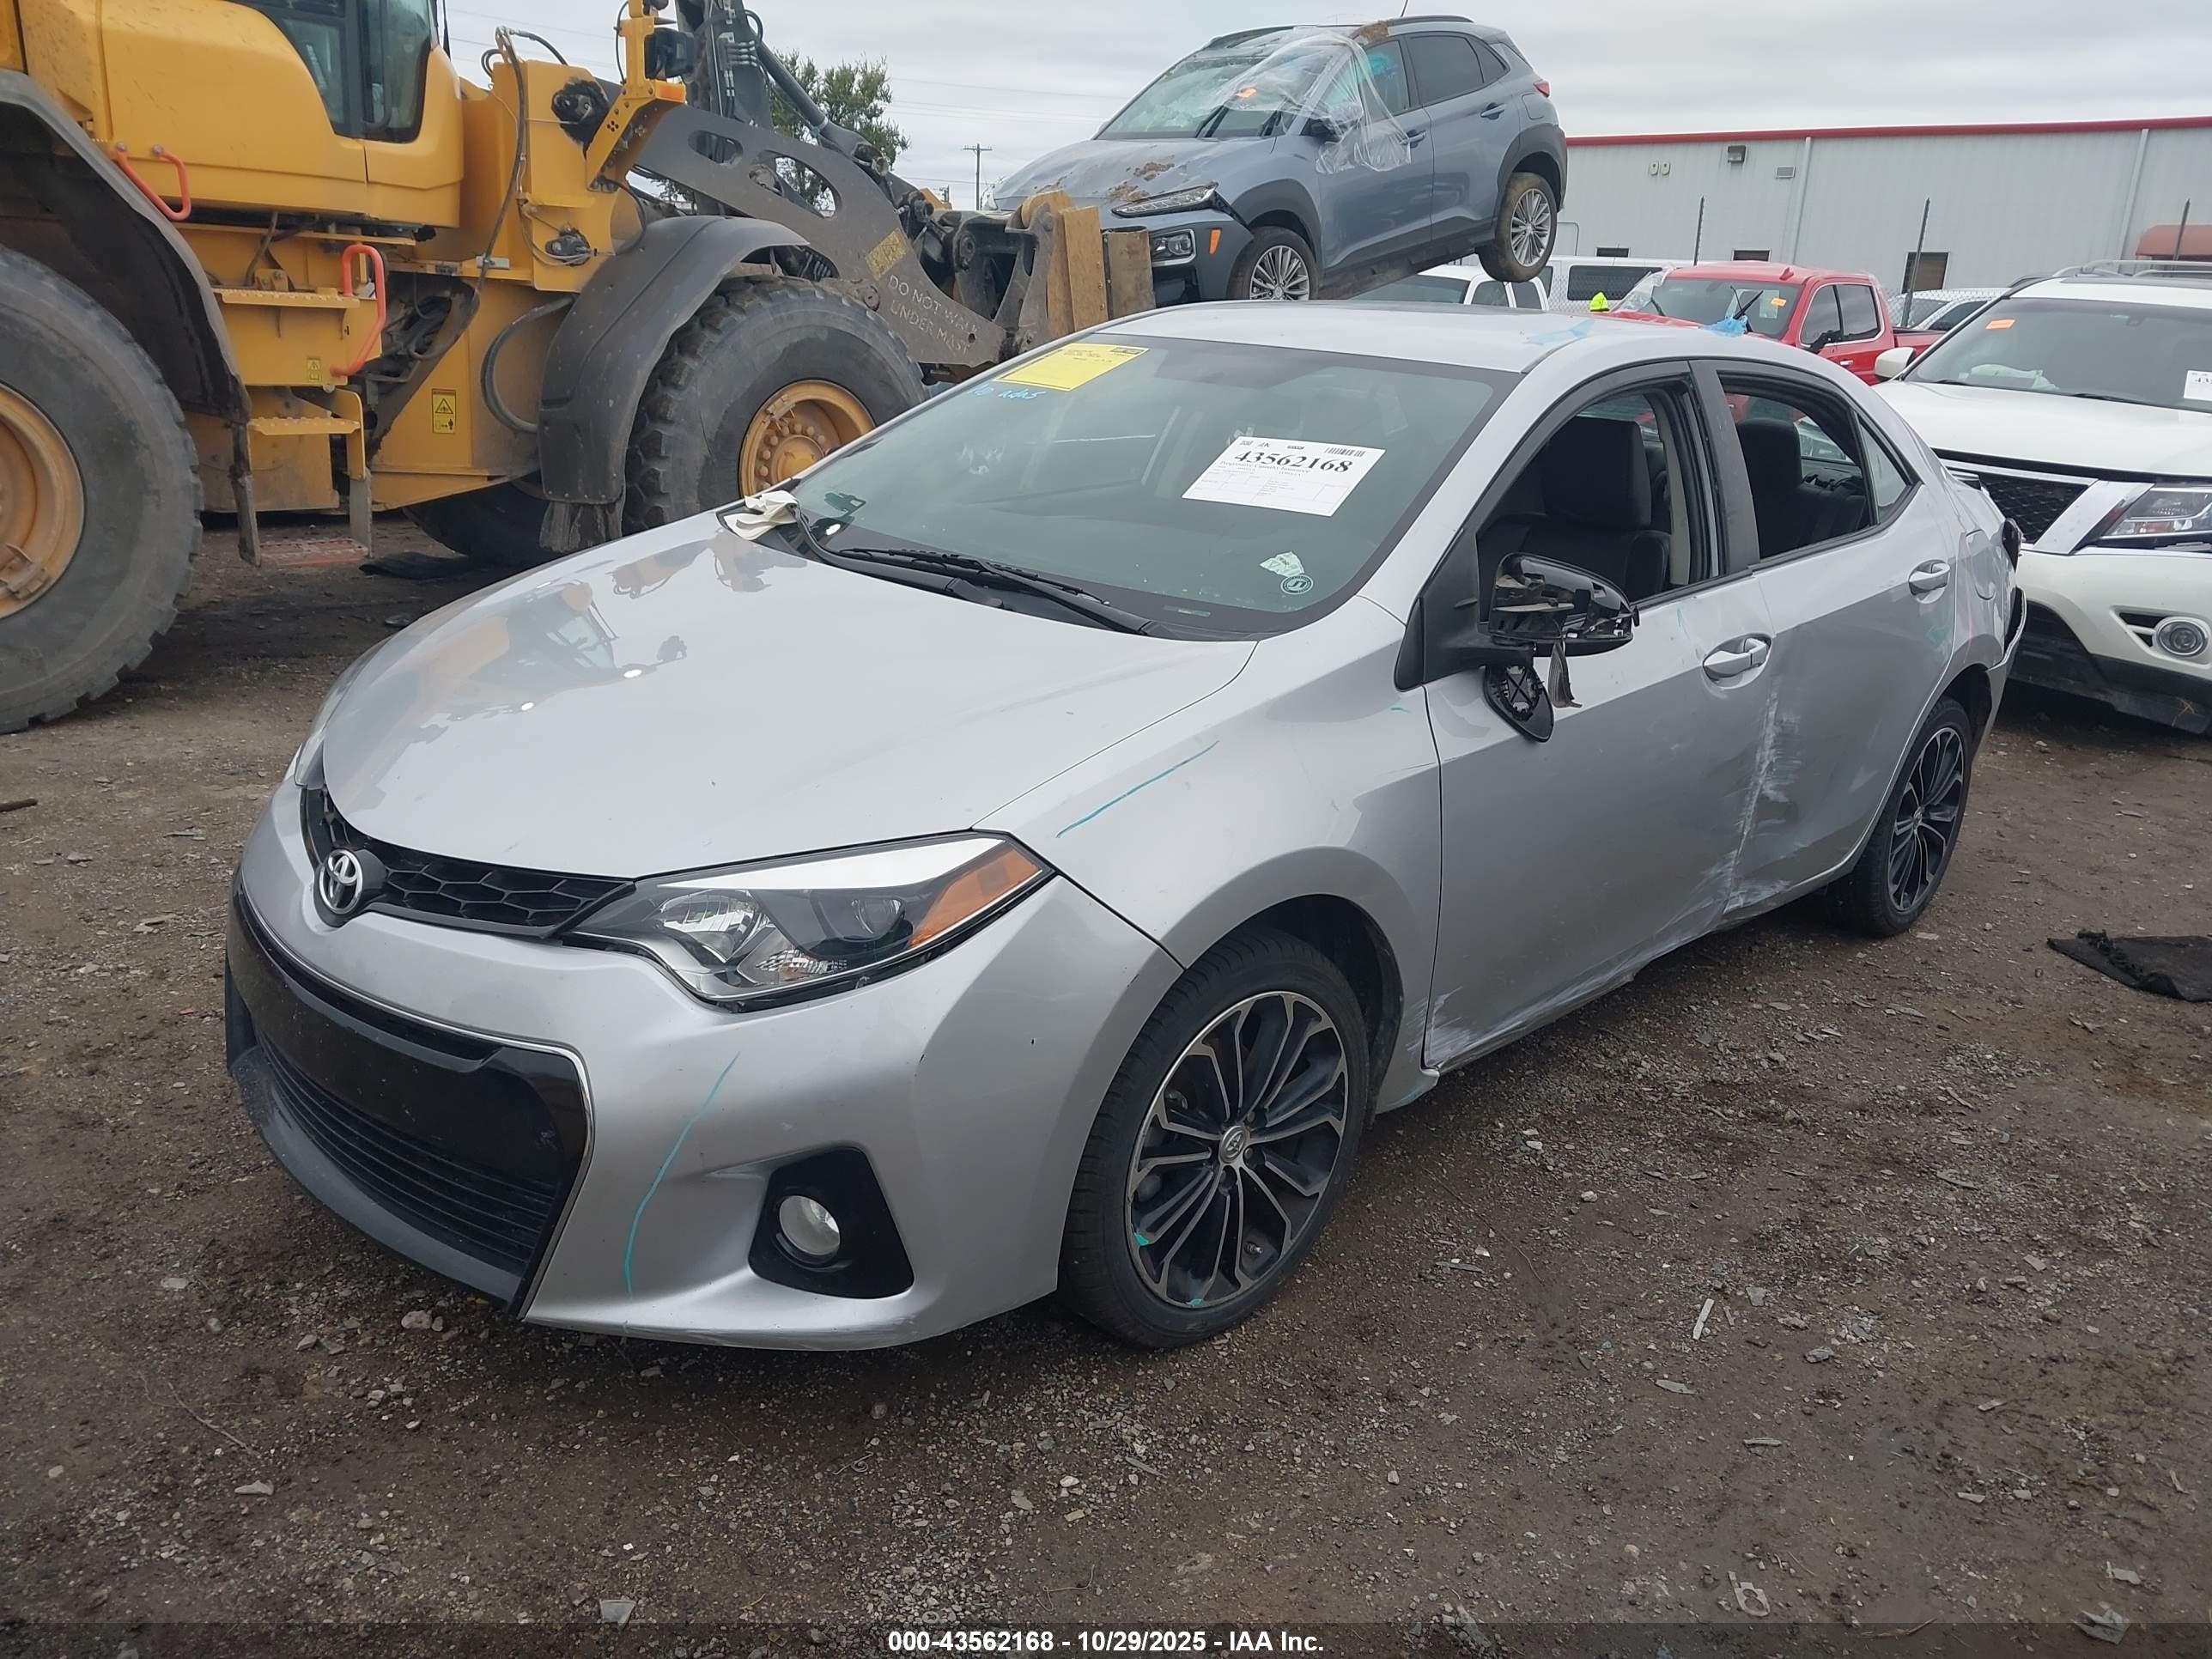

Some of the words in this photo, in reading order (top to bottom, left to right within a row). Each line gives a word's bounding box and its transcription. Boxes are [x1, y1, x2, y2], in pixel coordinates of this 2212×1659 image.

[888, 274, 909, 296] DO
[912, 289, 942, 315] NOT
[945, 308, 980, 333] WALK
[890, 300, 934, 336] UNDER
[936, 327, 971, 356] MAST
[1234, 450, 1353, 473] 43562168
